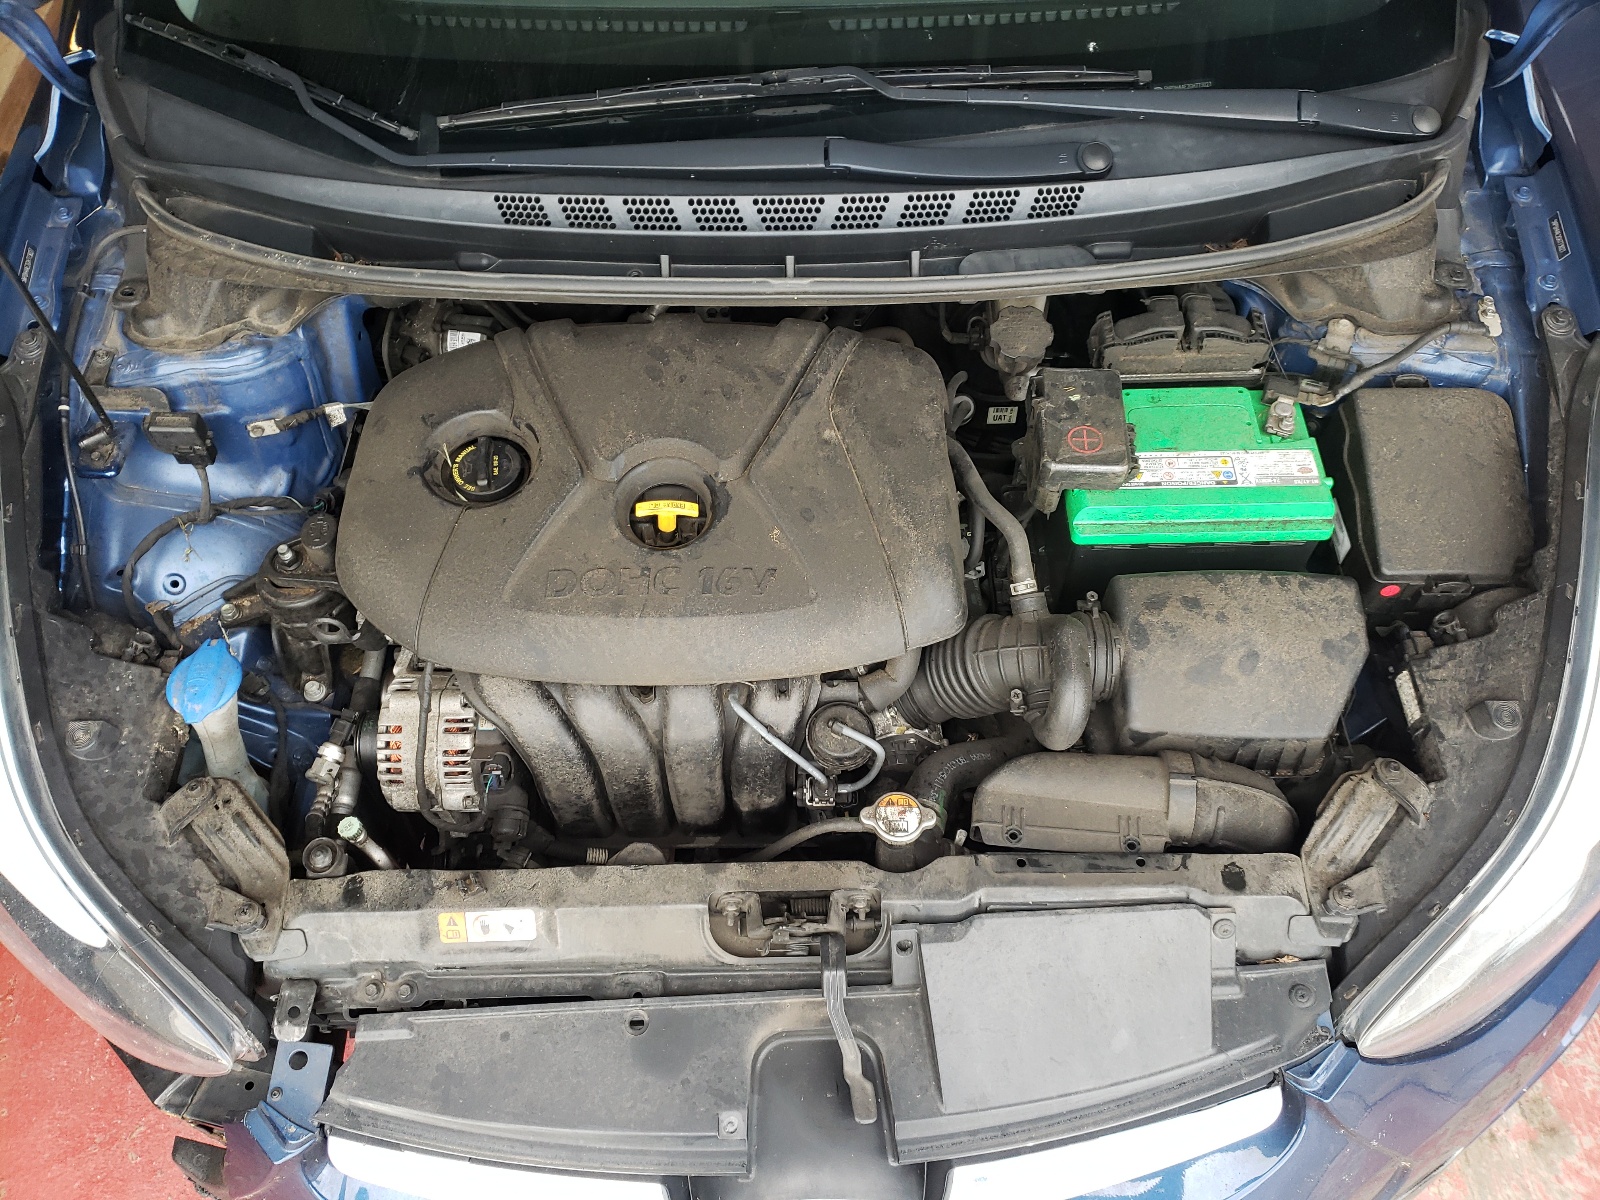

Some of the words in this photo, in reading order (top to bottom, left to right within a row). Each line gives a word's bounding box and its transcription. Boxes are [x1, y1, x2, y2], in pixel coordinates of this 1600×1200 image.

[455, 445, 477, 463] MANUAL
[452, 463, 465, 486] OWNER'S
[545, 566, 681, 598] DOHC
[698, 566, 778, 596] 16V
